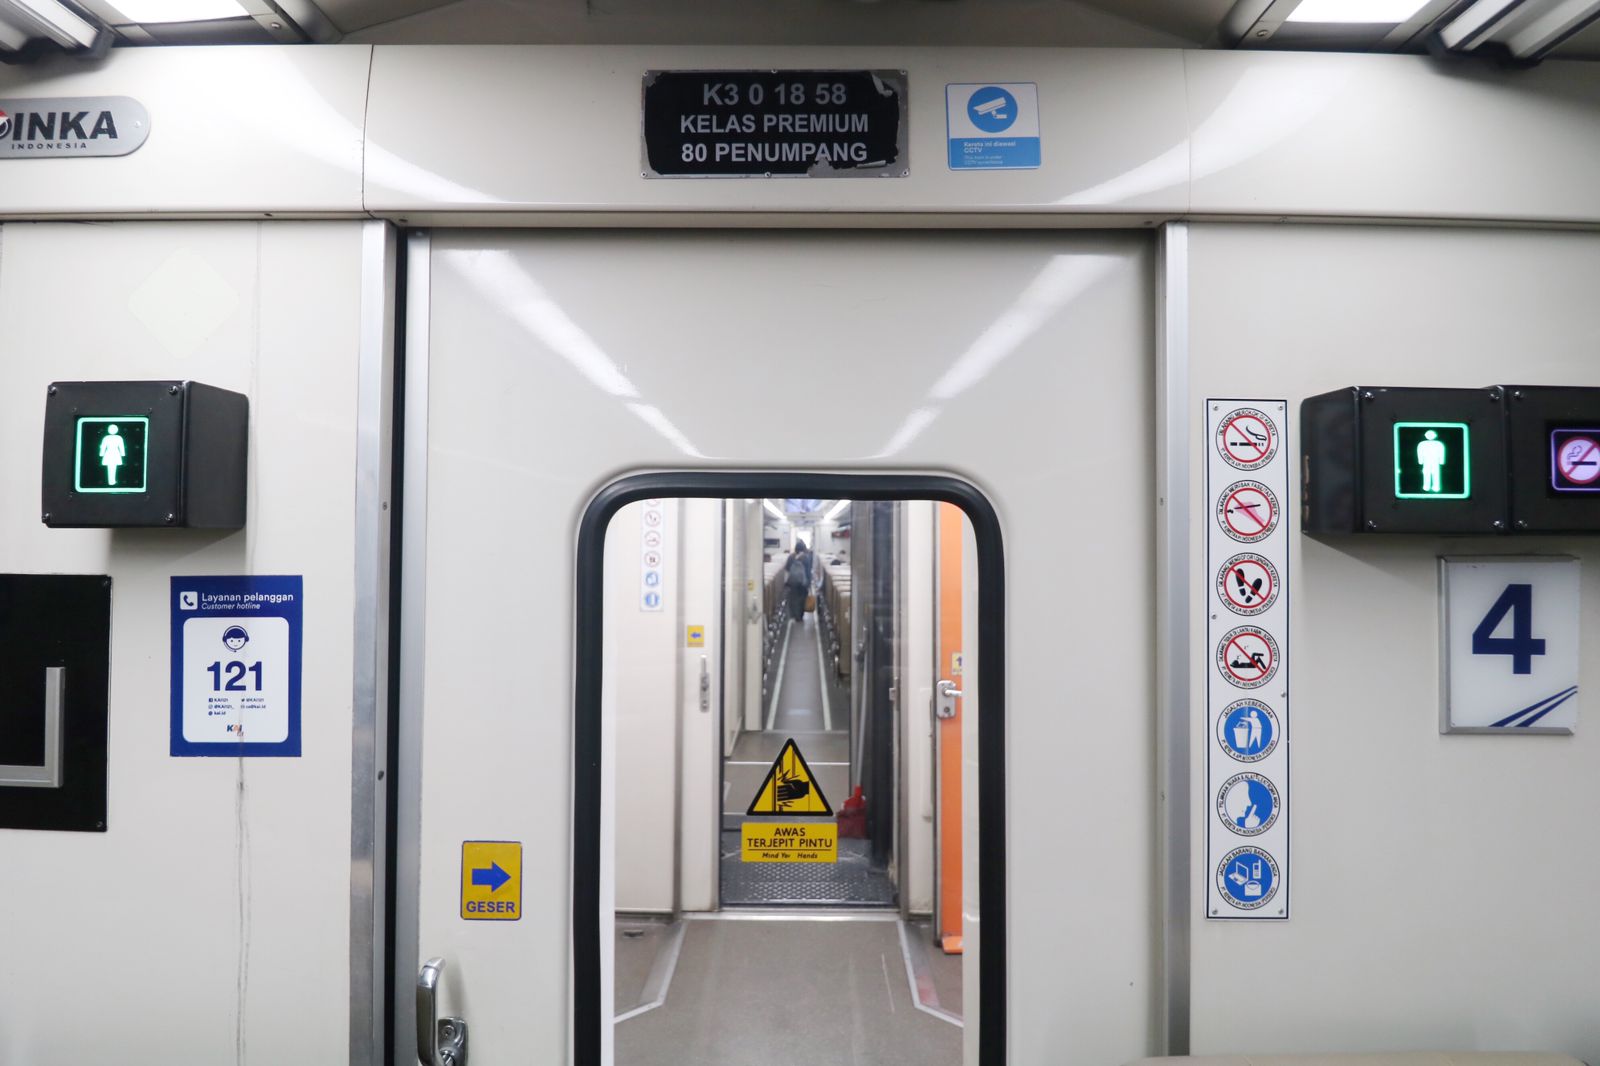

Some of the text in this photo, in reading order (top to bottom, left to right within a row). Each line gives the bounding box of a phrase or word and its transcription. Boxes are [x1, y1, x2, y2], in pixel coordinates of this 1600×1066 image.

[703, 83, 847, 105] K3 0 18 58
[12, 111, 118, 140] INKA
[680, 114, 869, 133] KELAS PREMIUM
[682, 142, 868, 162] 80 PENUMPANG
[202, 592, 294, 603] Layanan pelanggan
[1472, 584, 1546, 674] 4
[207, 660, 262, 691] 121
[774, 828, 806, 836] AWAS
[747, 838, 832, 847] TERJEPIT PINTU
[466, 901, 515, 913] GESER
